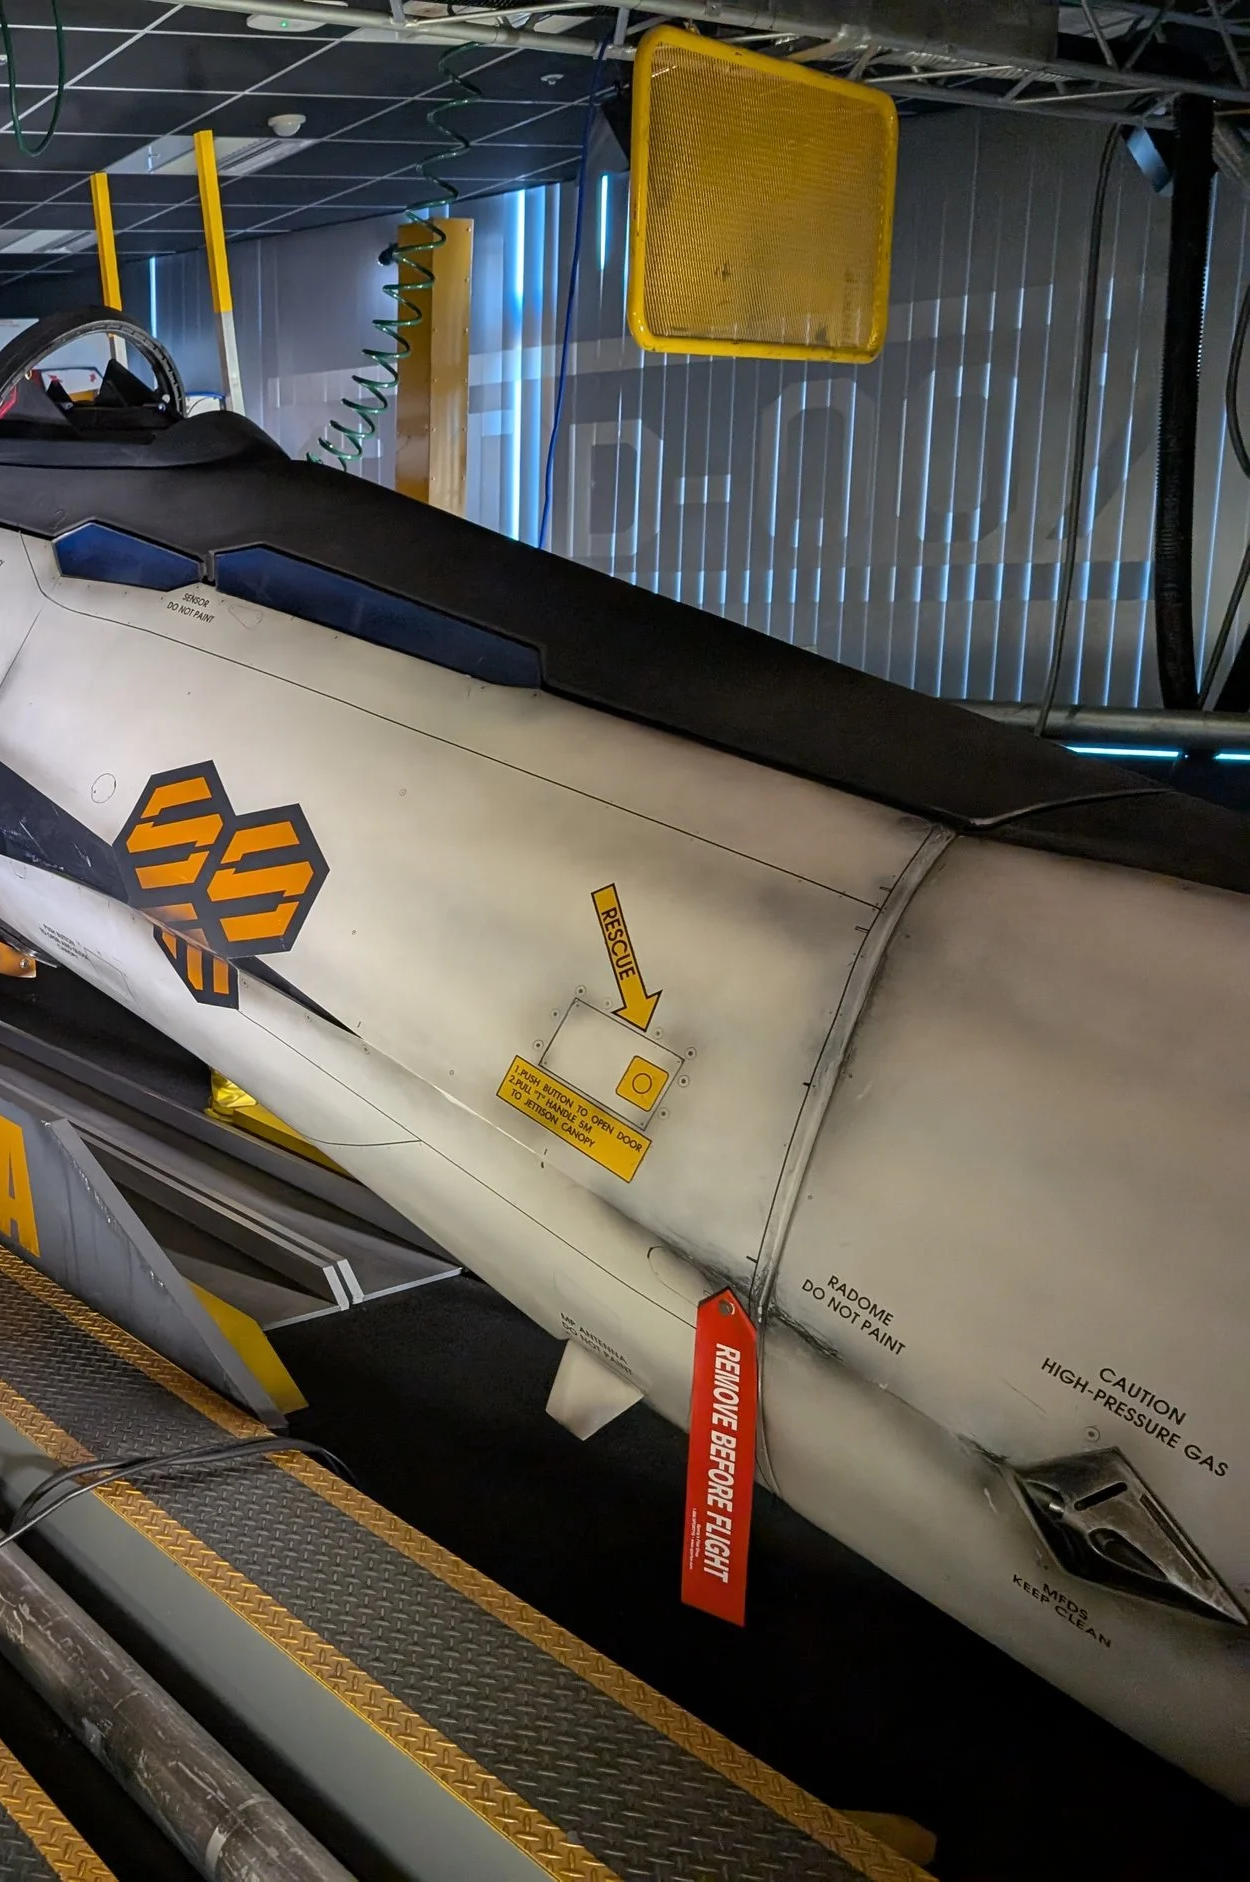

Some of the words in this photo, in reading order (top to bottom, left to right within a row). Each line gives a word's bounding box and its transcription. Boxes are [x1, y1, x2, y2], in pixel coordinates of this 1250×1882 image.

[166, 601, 179, 611] DO
[179, 605, 195, 616] NOT
[193, 610, 215, 624] PAINT
[182, 593, 210, 608] SENSOR
[601, 906, 636, 981] RESCUE
[508, 1075, 533, 1096] 2.PULL
[545, 1095, 578, 1123] HANDLE
[578, 1117, 594, 1134] 5M
[511, 1087, 522, 1101] TO
[523, 1096, 560, 1125] JETTISON
[560, 1121, 597, 1150] CANOPY
[514, 1065, 541, 1088] 1.PUSH
[542, 1080, 575, 1109] BUTTON
[576, 1102, 588, 1118] TO
[590, 1112, 615, 1135] OPEN
[616, 1128, 644, 1152] DOOR
[802, 1279, 826, 1300] DO
[827, 1296, 861, 1324] NOT
[860, 1319, 906, 1355] PAINT
[827, 1275, 894, 1327] RADOME
[562, 1321, 578, 1336] DO
[580, 1334, 601, 1353] NOT
[580, 1327, 629, 1366] ANTENNA
[711, 1342, 741, 1431] REMOVE
[1041, 1357, 1186, 1450] HIGH-PRESSURE
[1184, 1444, 1230, 1477] GAS
[1099, 1367, 1187, 1426] CAUTION
[707, 1429, 738, 1513] BEFORE
[703, 1510, 732, 1583] FLIGHT
[1013, 1574, 1050, 1604] KEEP
[1054, 1606, 1112, 1648] CLEAN
[1042, 1582, 1089, 1621] MFDS
